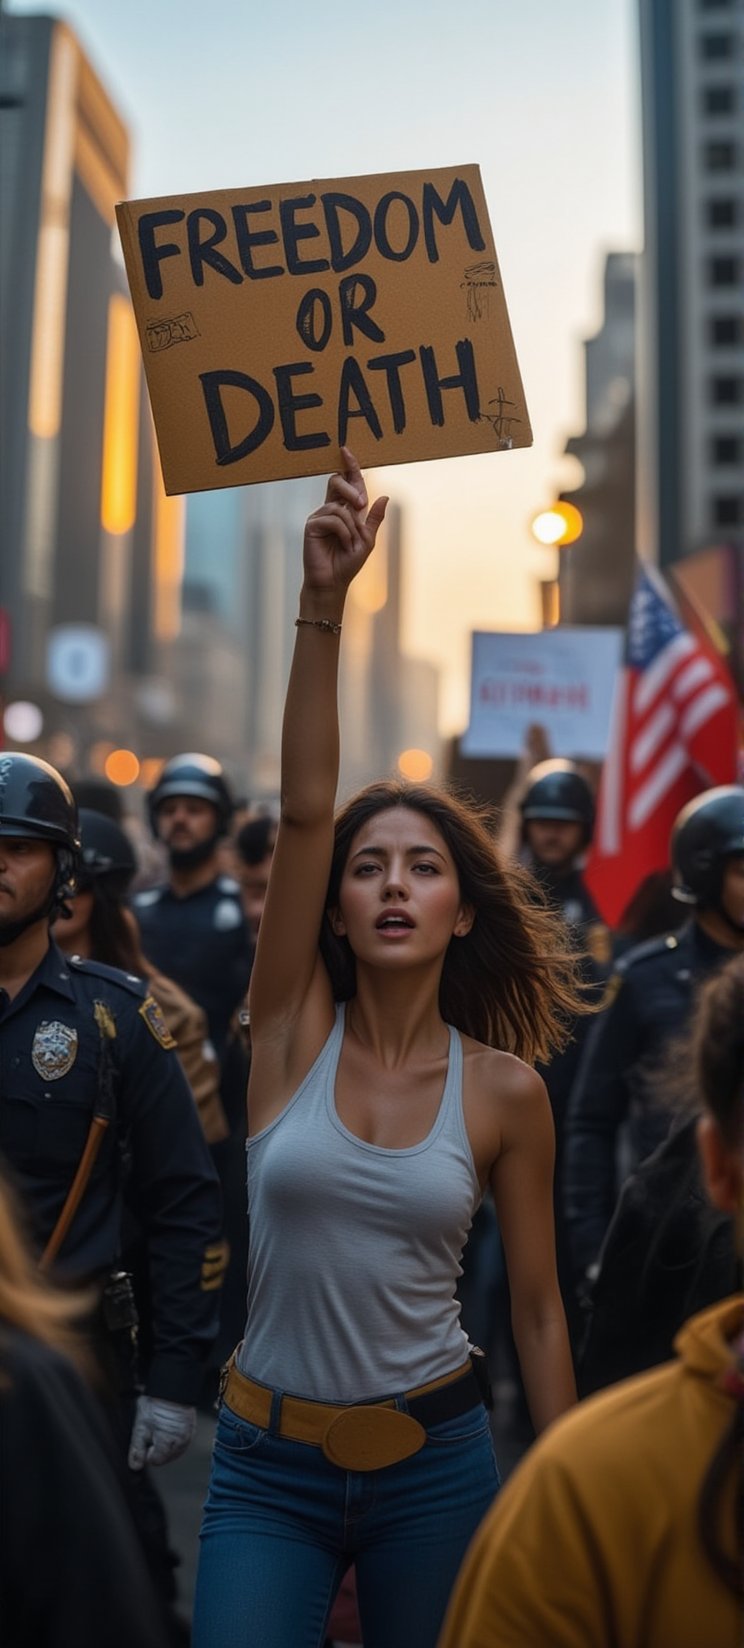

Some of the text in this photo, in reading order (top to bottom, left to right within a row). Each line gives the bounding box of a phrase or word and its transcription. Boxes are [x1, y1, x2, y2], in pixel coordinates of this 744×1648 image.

[138, 178, 486, 300] FREEDOM
[296, 273, 386, 352] OR
[198, 338, 482, 467] DEATH
